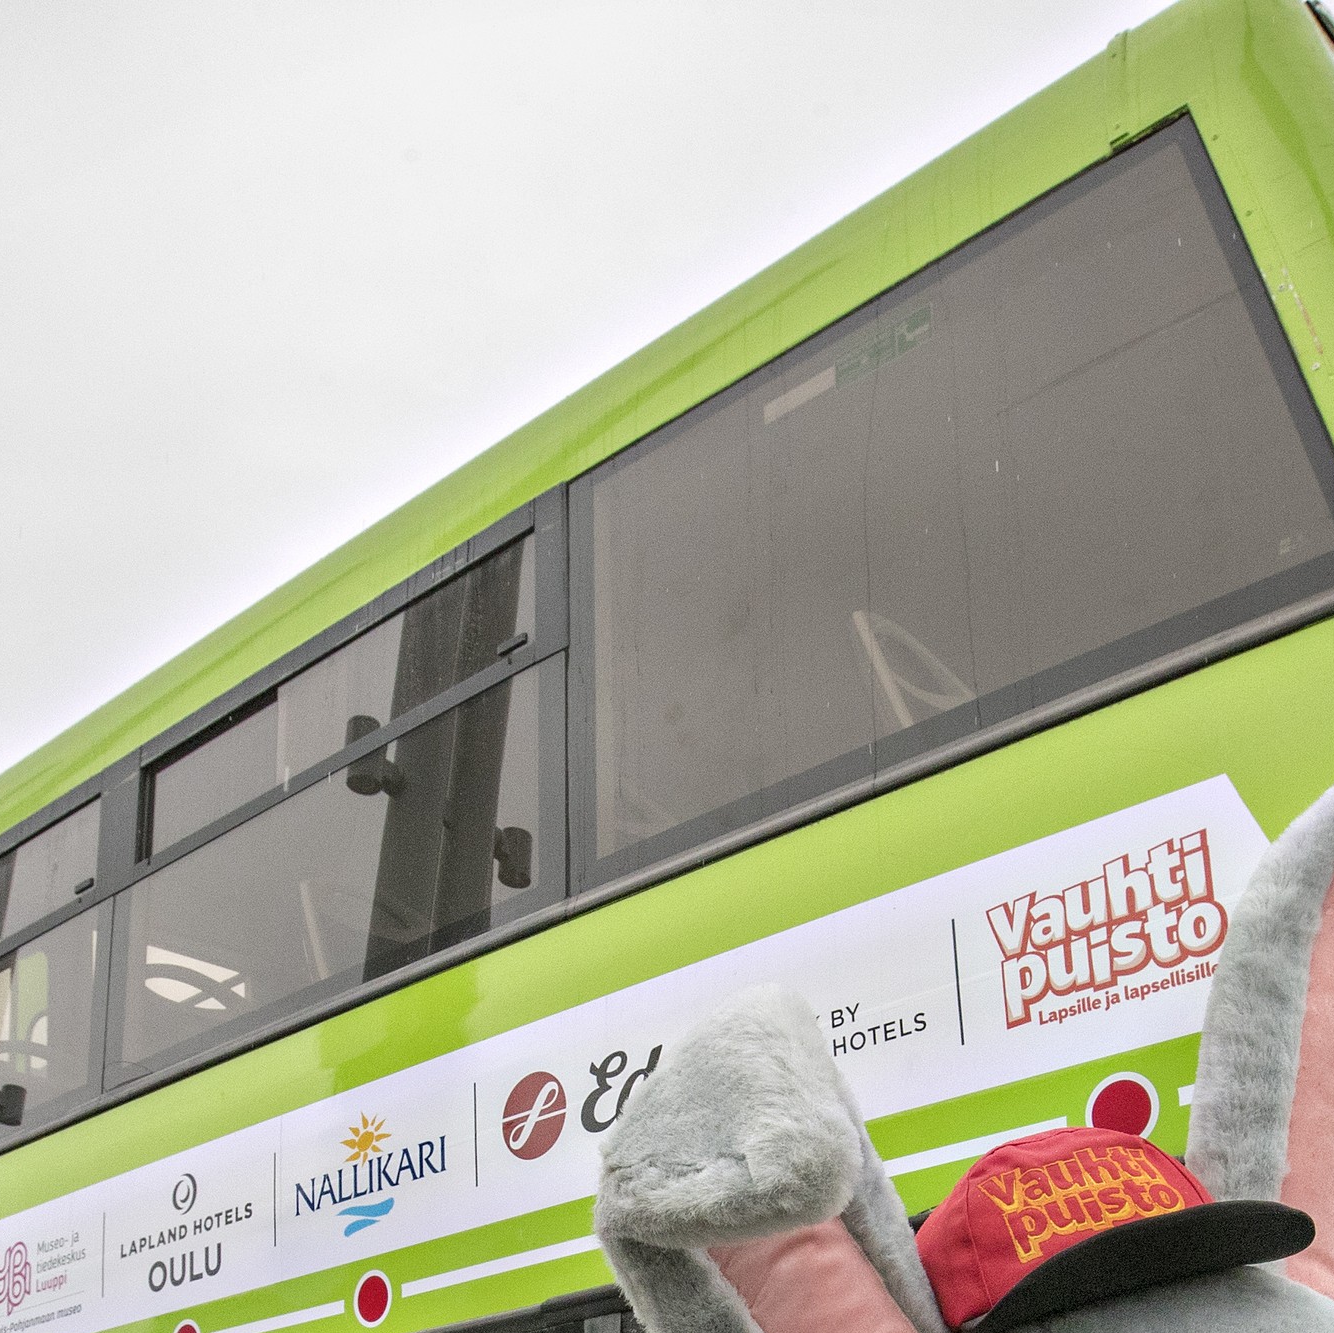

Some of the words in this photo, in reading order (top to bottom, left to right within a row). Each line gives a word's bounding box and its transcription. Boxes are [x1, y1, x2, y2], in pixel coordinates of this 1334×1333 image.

[986, 828, 1214, 961] Vauhti
[1001, 899, 1229, 1030] puisto
[830, 1002, 861, 1029] BY
[831, 1011, 929, 1057] HOTELS
[1038, 993, 1102, 1026] Lapsille
[1104, 990, 1121, 1011] ja
[580, 1043, 664, 1133] Ed
[294, 1135, 447, 1218] NALLIKARI
[977, 1146, 1160, 1212] Vauhti
[36, 1236, 68, 1255] Museo-
[119, 1223, 188, 1259] LAPLAND
[192, 1202, 254, 1236] HOTELS
[1002, 1178, 1186, 1264] puisto
[35, 1269, 68, 1293] Luuppi
[148, 1242, 222, 1292] OULU
